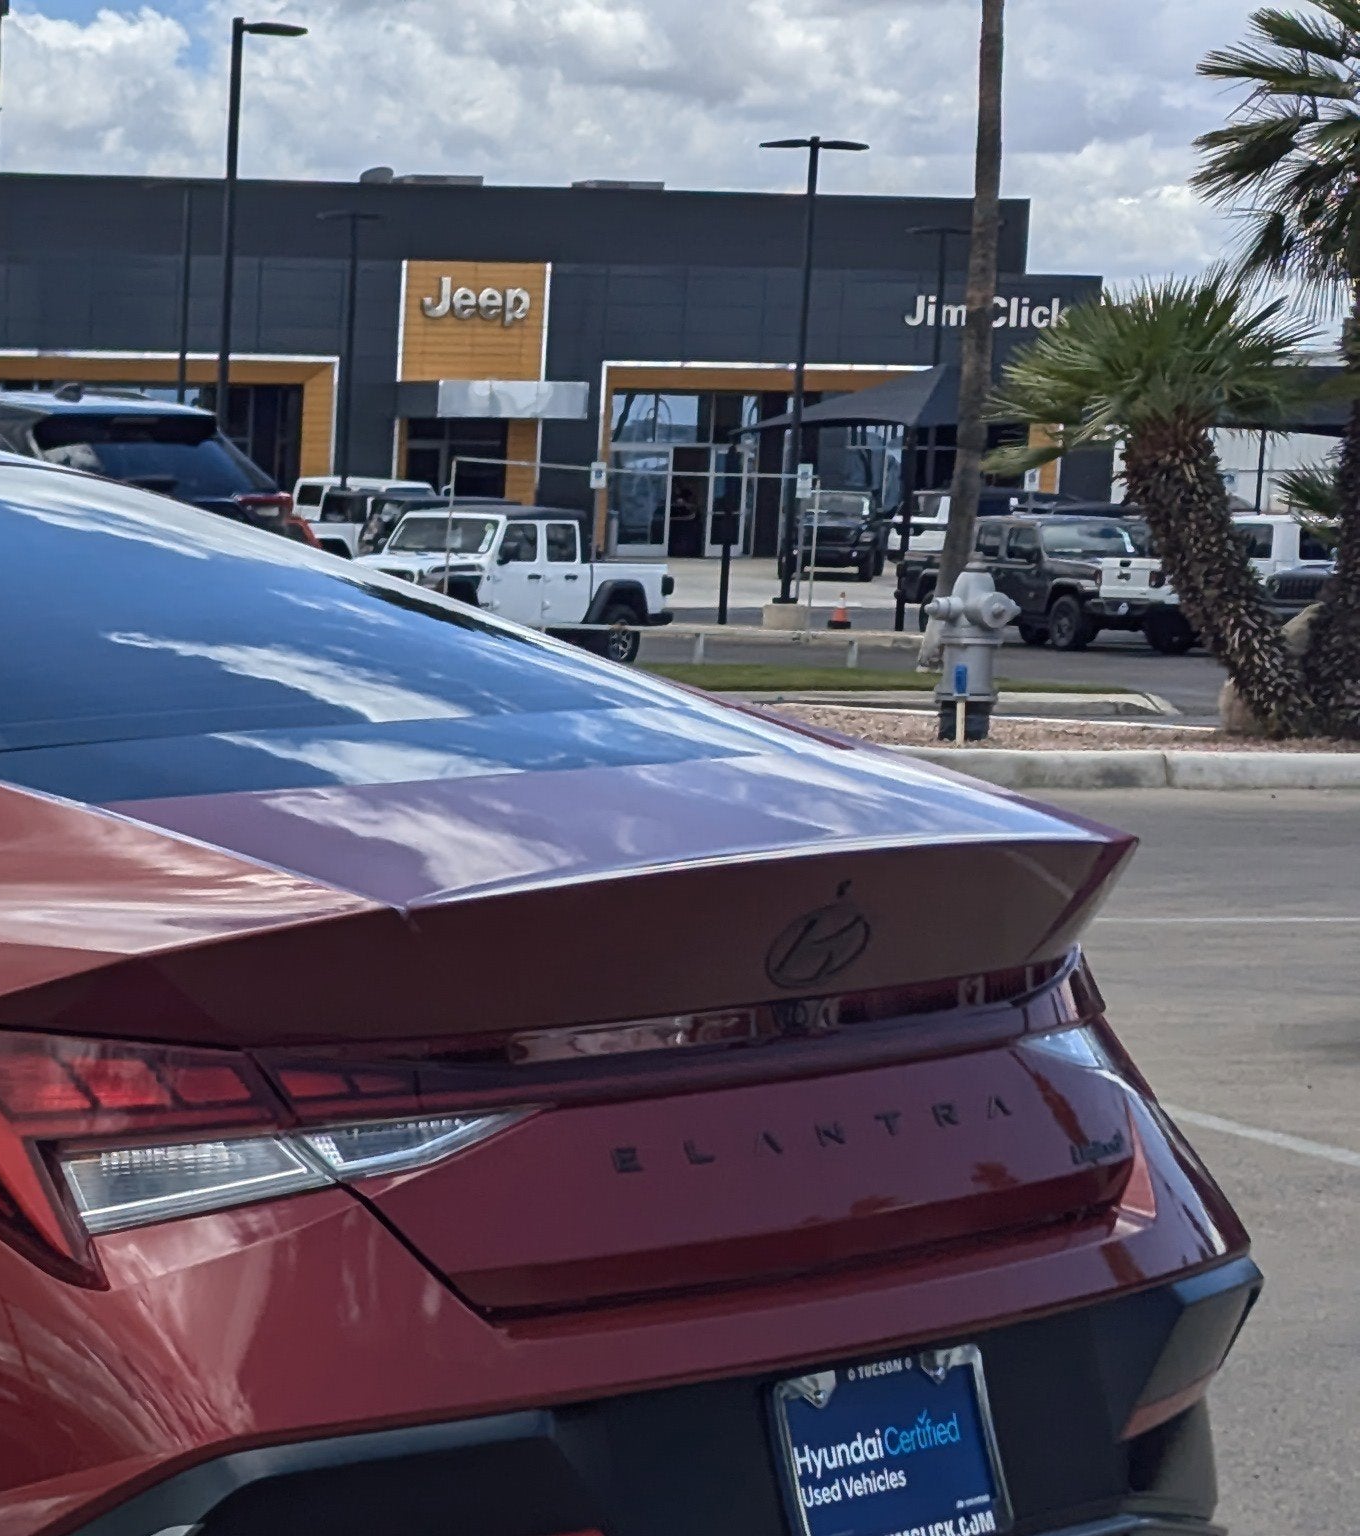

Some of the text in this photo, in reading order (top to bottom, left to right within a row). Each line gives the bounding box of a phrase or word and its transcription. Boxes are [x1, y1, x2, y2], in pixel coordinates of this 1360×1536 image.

[422, 276, 531, 327] Jeep
[904, 294, 1072, 328] Jim Click
[611, 1095, 1012, 1174] ELANTRA
[793, 1409, 961, 1480] Hyundai Certified
[800, 1467, 907, 1508] Used Vehicles
